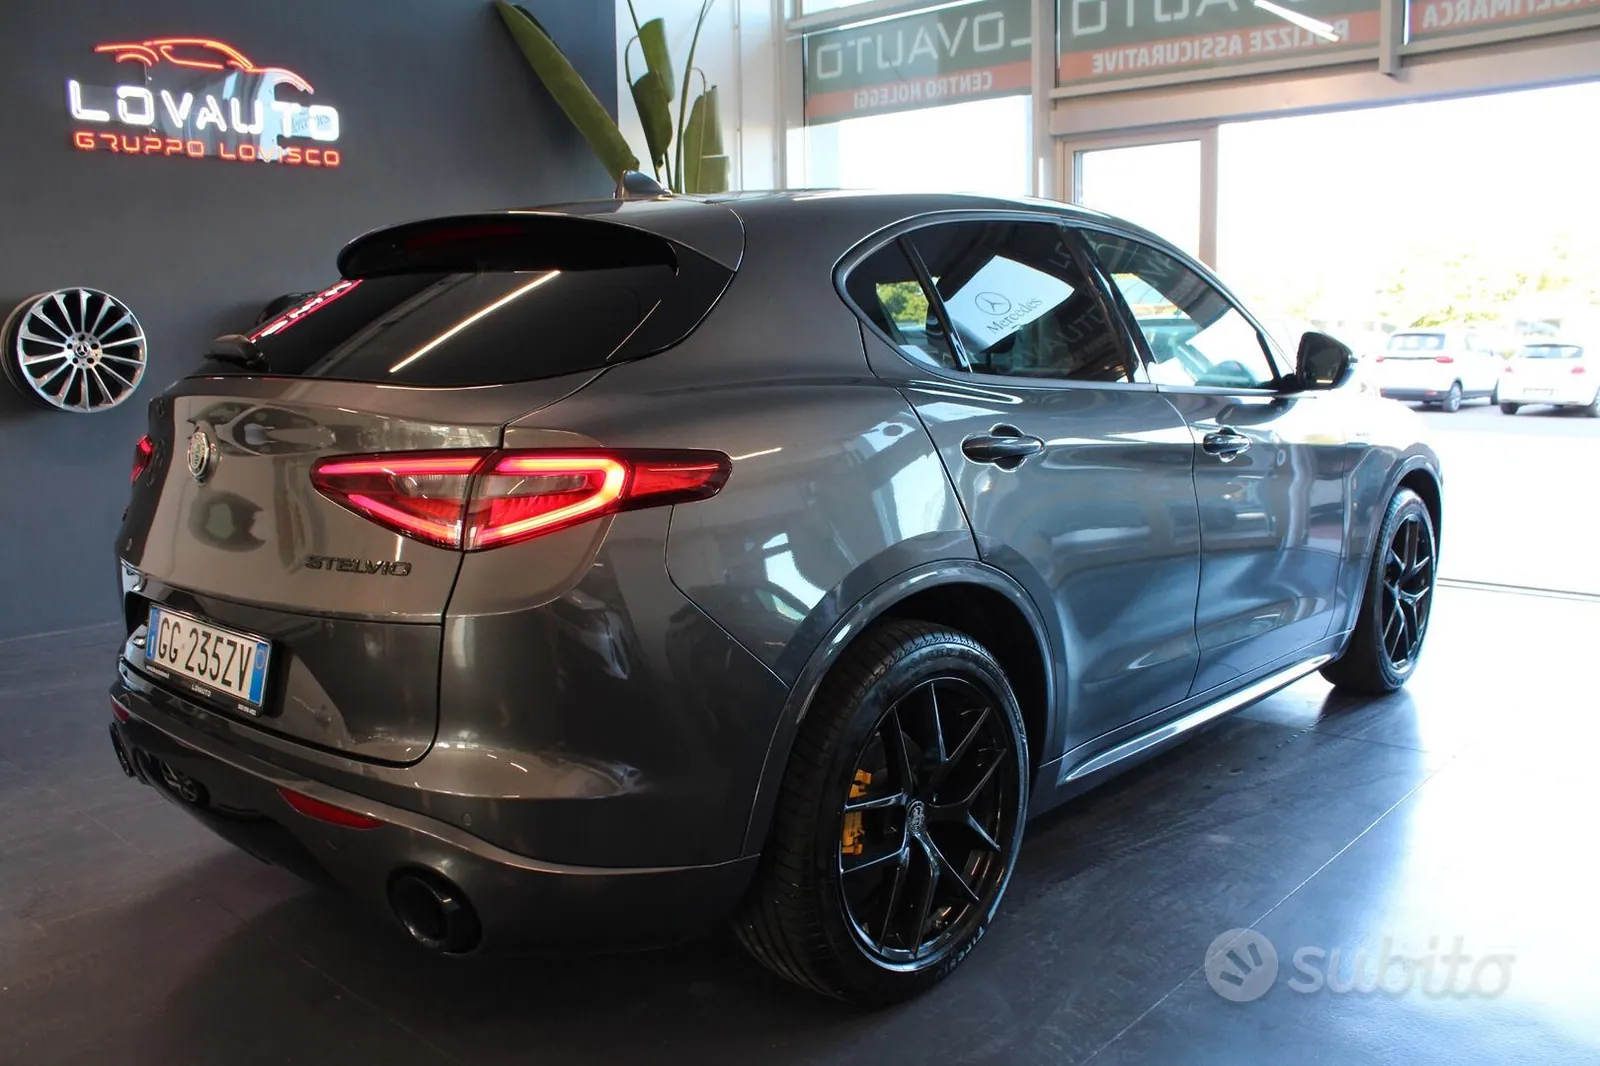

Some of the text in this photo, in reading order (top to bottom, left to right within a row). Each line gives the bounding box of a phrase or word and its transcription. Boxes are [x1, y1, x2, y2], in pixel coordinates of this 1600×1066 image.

[67, 78, 340, 142] LOVAUTO
[74, 131, 341, 166] GRUPPO LOVISCO
[986, 296, 1044, 335] Mercedes
[304, 554, 413, 577] STELVIO
[158, 616, 253, 692] GG 235ZV
